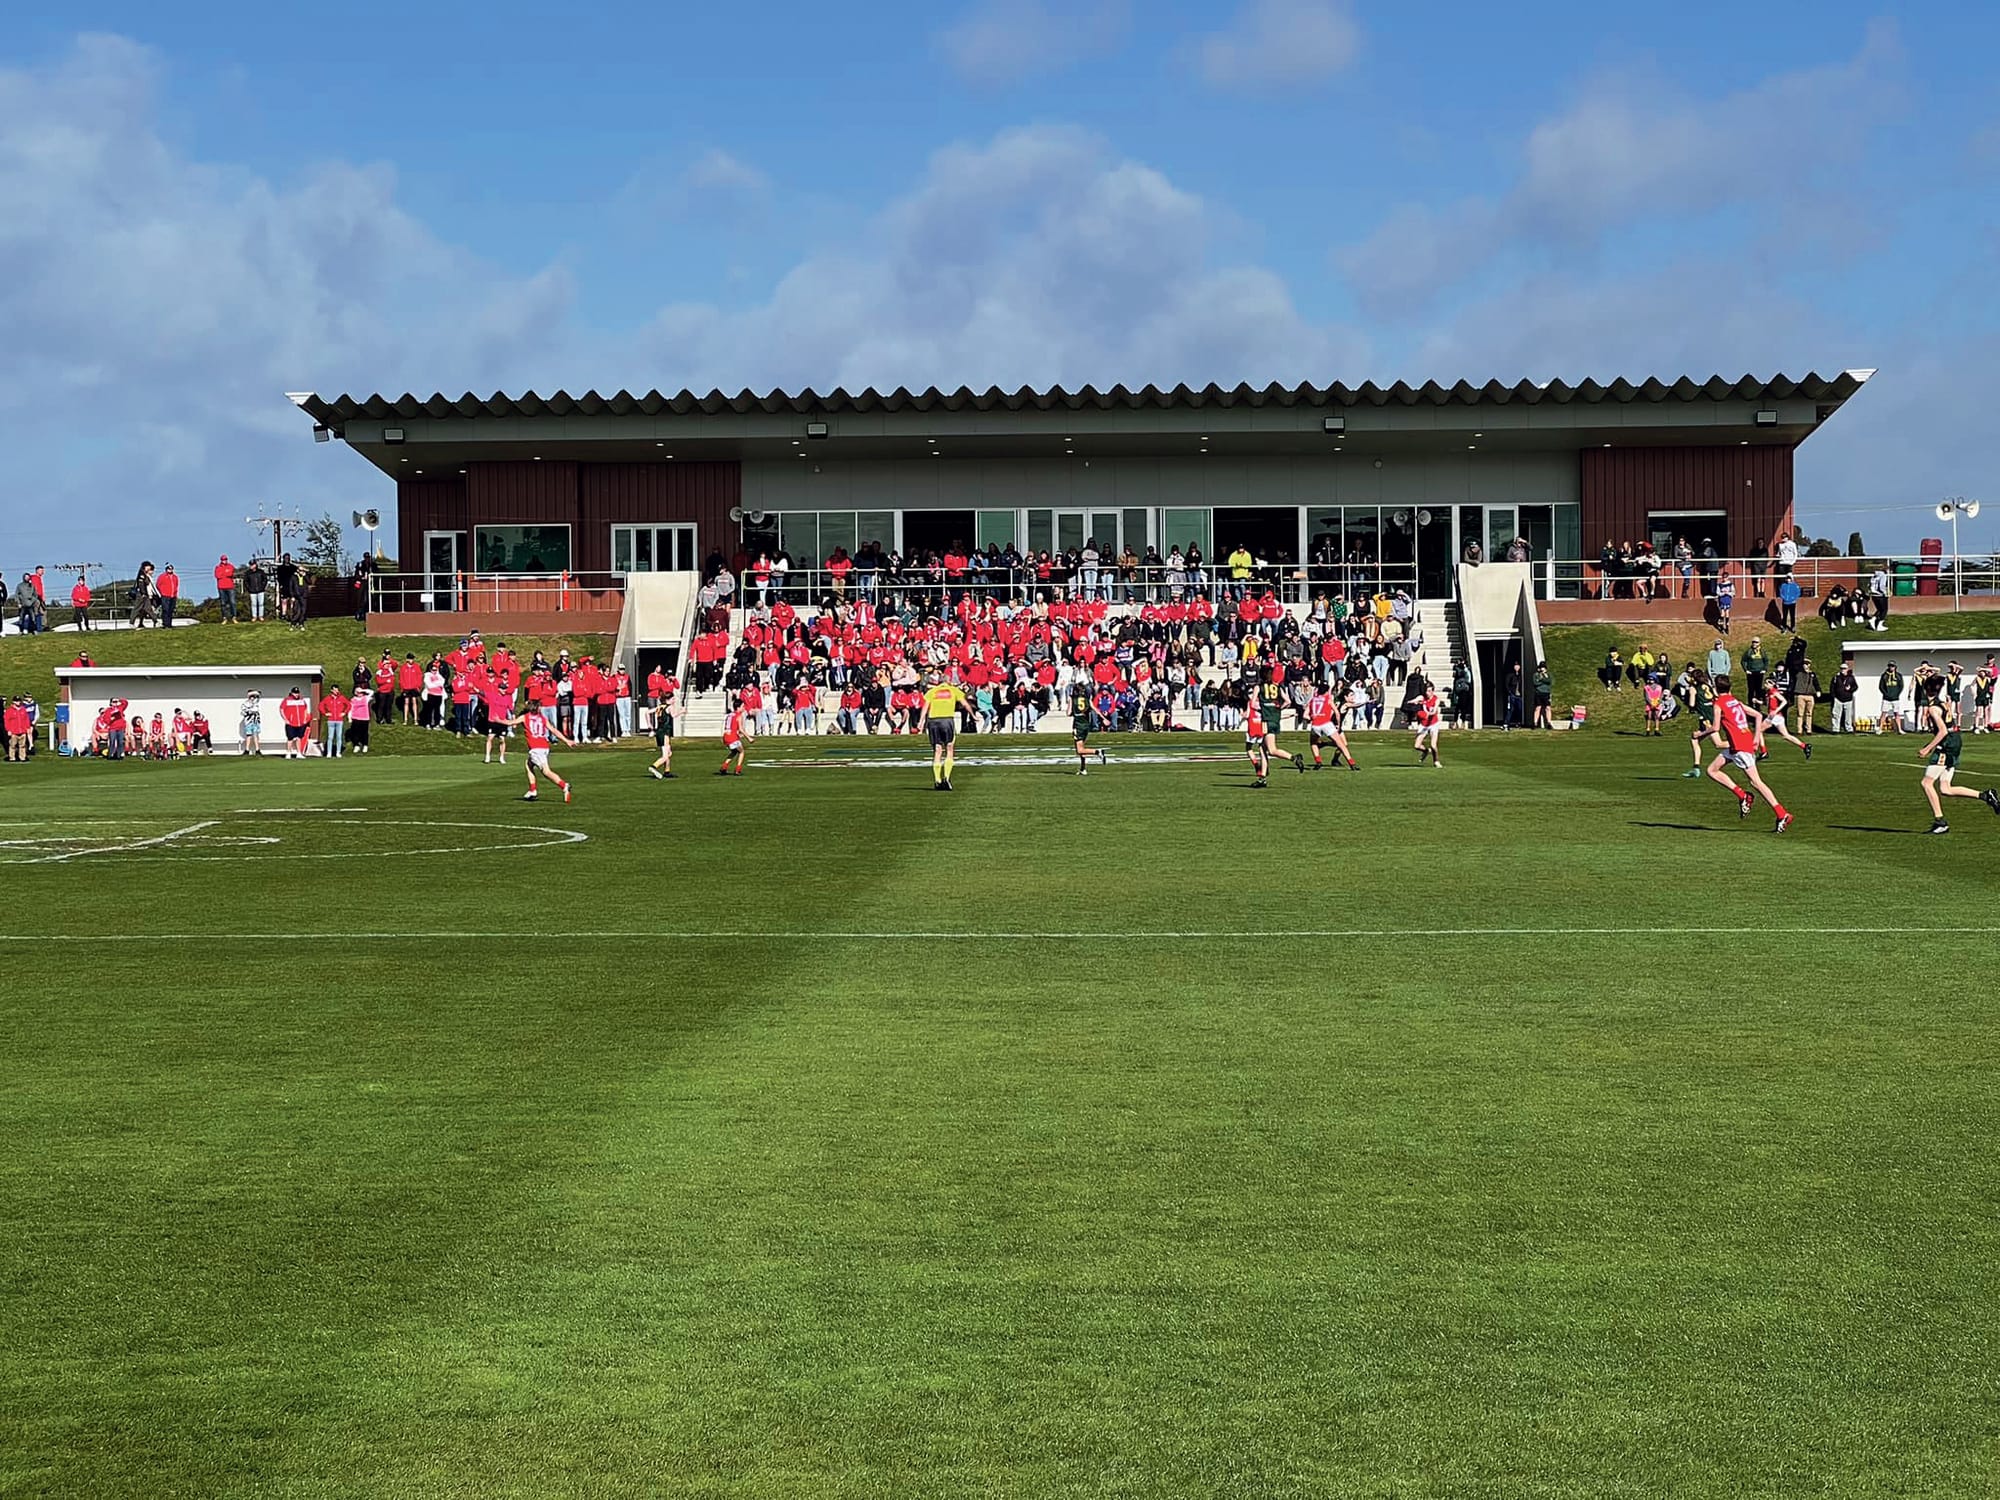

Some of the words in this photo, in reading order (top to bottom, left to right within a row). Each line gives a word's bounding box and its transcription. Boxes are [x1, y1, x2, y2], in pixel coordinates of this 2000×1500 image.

[1264, 683, 1279, 699] 19
[1701, 684, 1713, 699] 3
[1078, 697, 1086, 711] 5
[1312, 701, 1324, 715] 17
